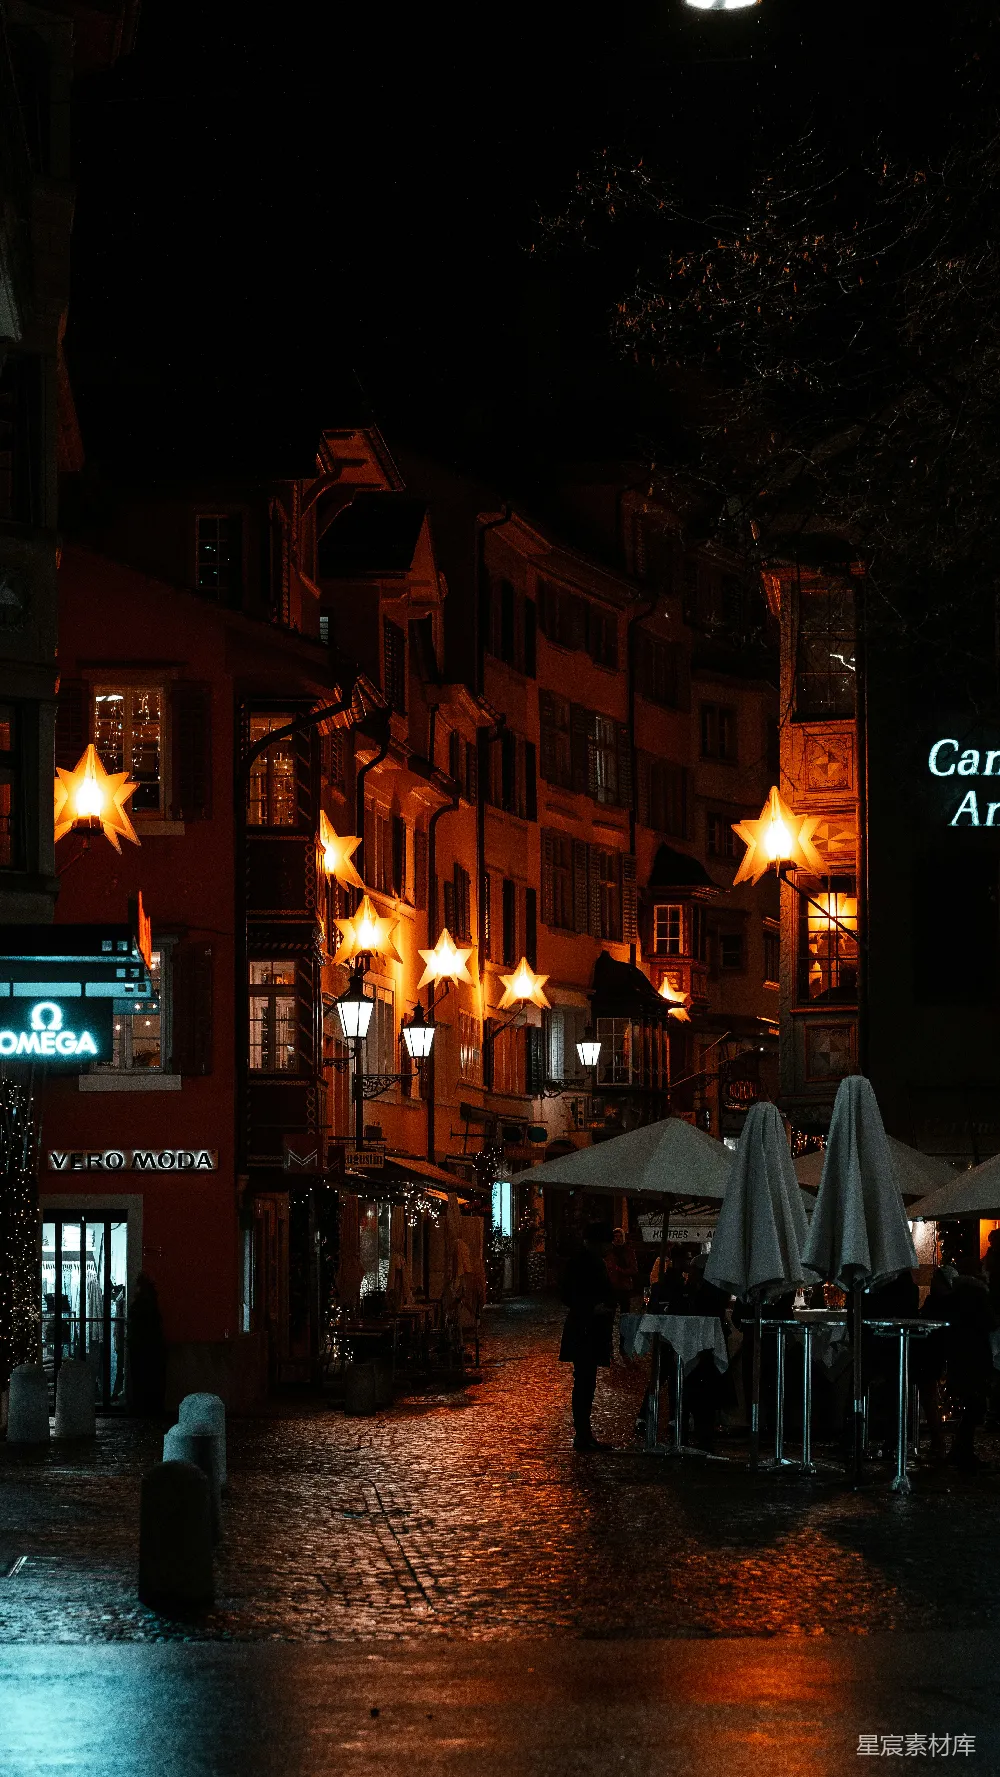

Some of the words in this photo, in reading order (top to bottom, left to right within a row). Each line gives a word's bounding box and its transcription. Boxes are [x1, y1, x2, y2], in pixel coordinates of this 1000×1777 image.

[0, 1030, 98, 1055] OMEGA
[51, 1152, 124, 1169] VERO
[131, 1152, 213, 1169] MODA
[346, 1153, 383, 1166] ugustin
[652, 1230, 689, 1239] HUTRES
